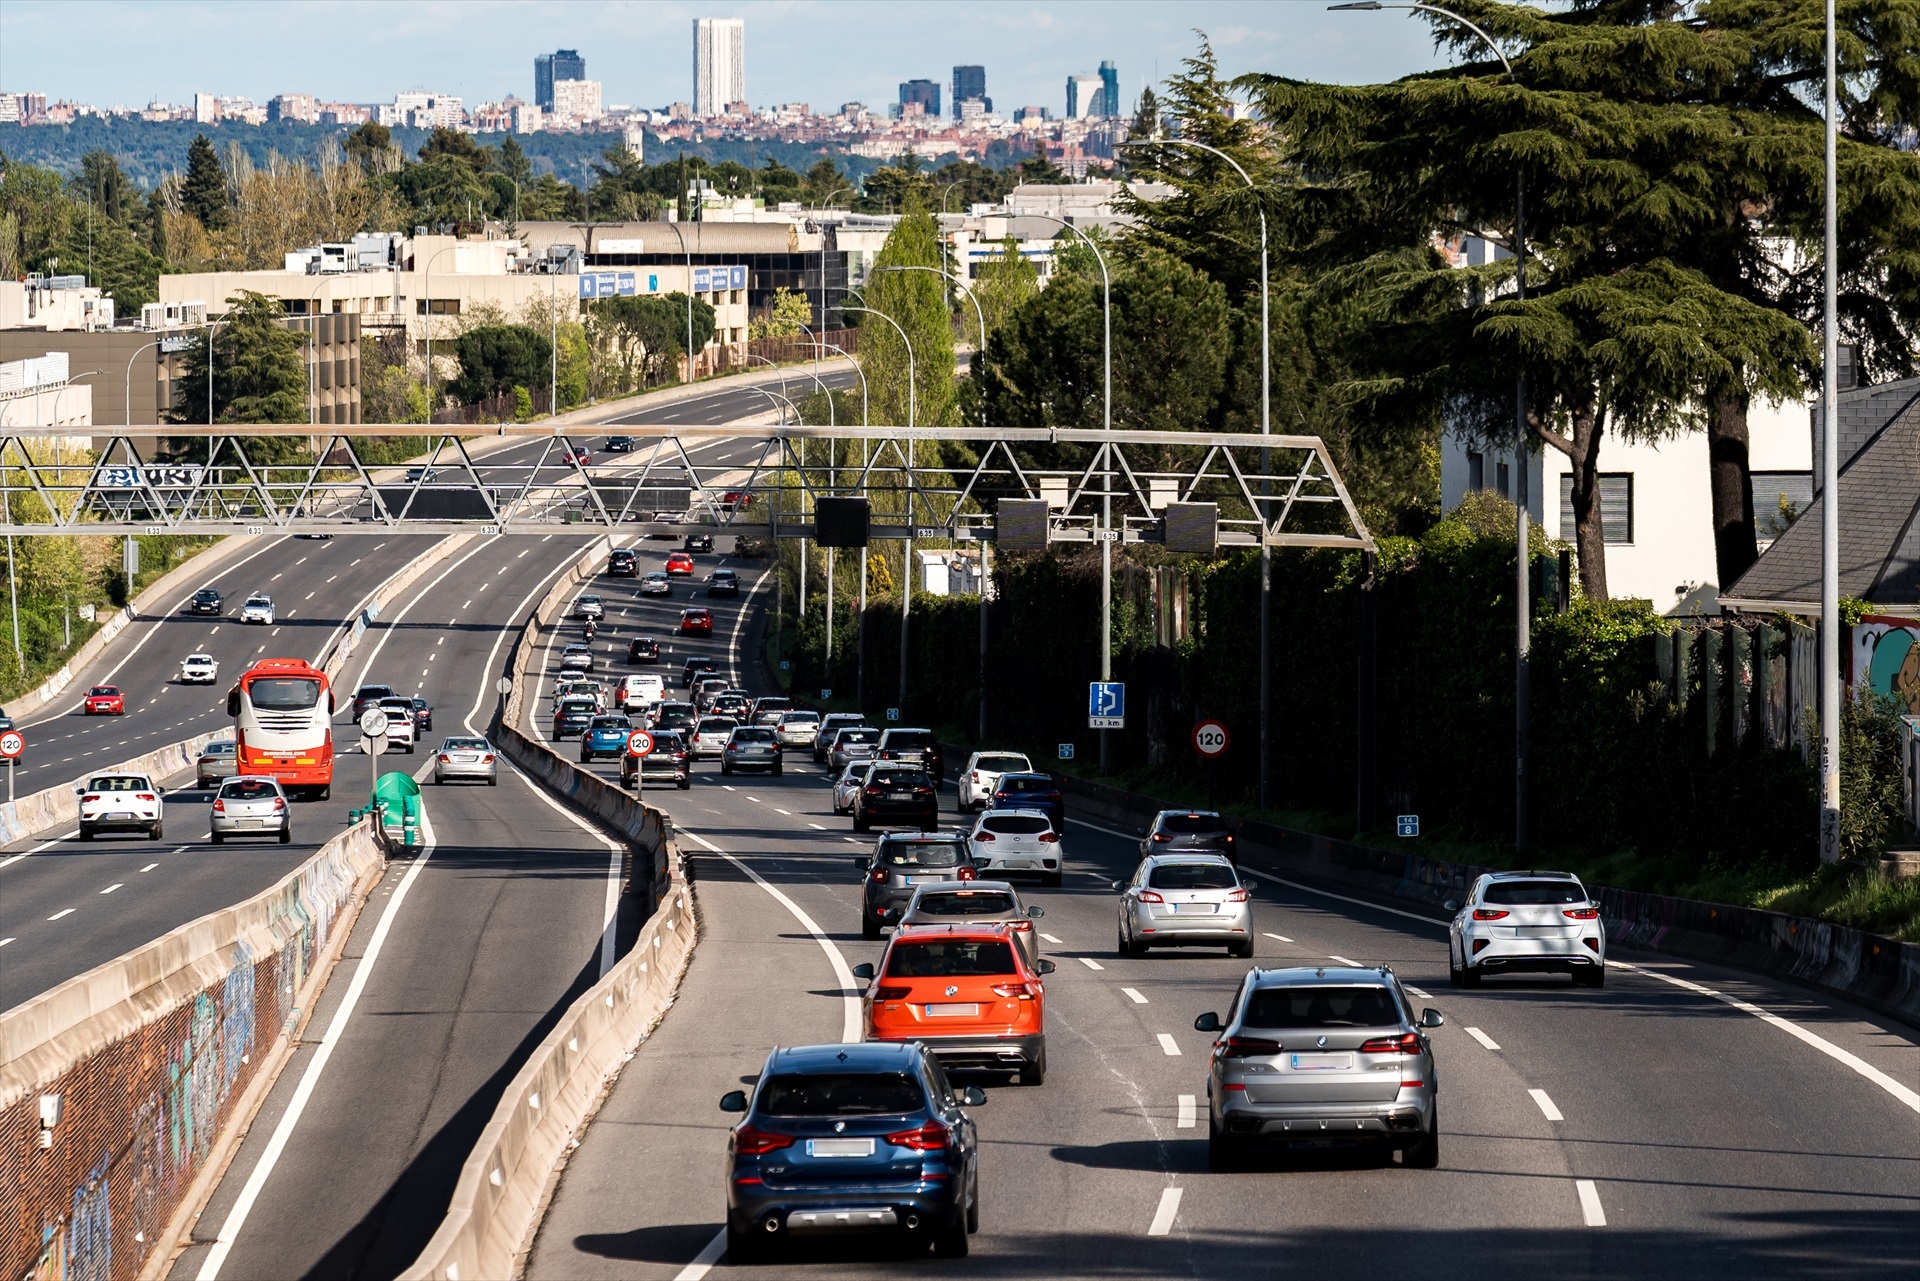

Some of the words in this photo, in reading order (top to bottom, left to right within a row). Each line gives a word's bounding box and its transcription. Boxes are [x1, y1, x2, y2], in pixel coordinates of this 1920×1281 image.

[1107, 719, 1120, 727] km
[631, 739, 650, 748] 120
[1198, 732, 1225, 746] 120
[2, 740, 20, 749] 120
[1405, 826, 1412, 834] 8
